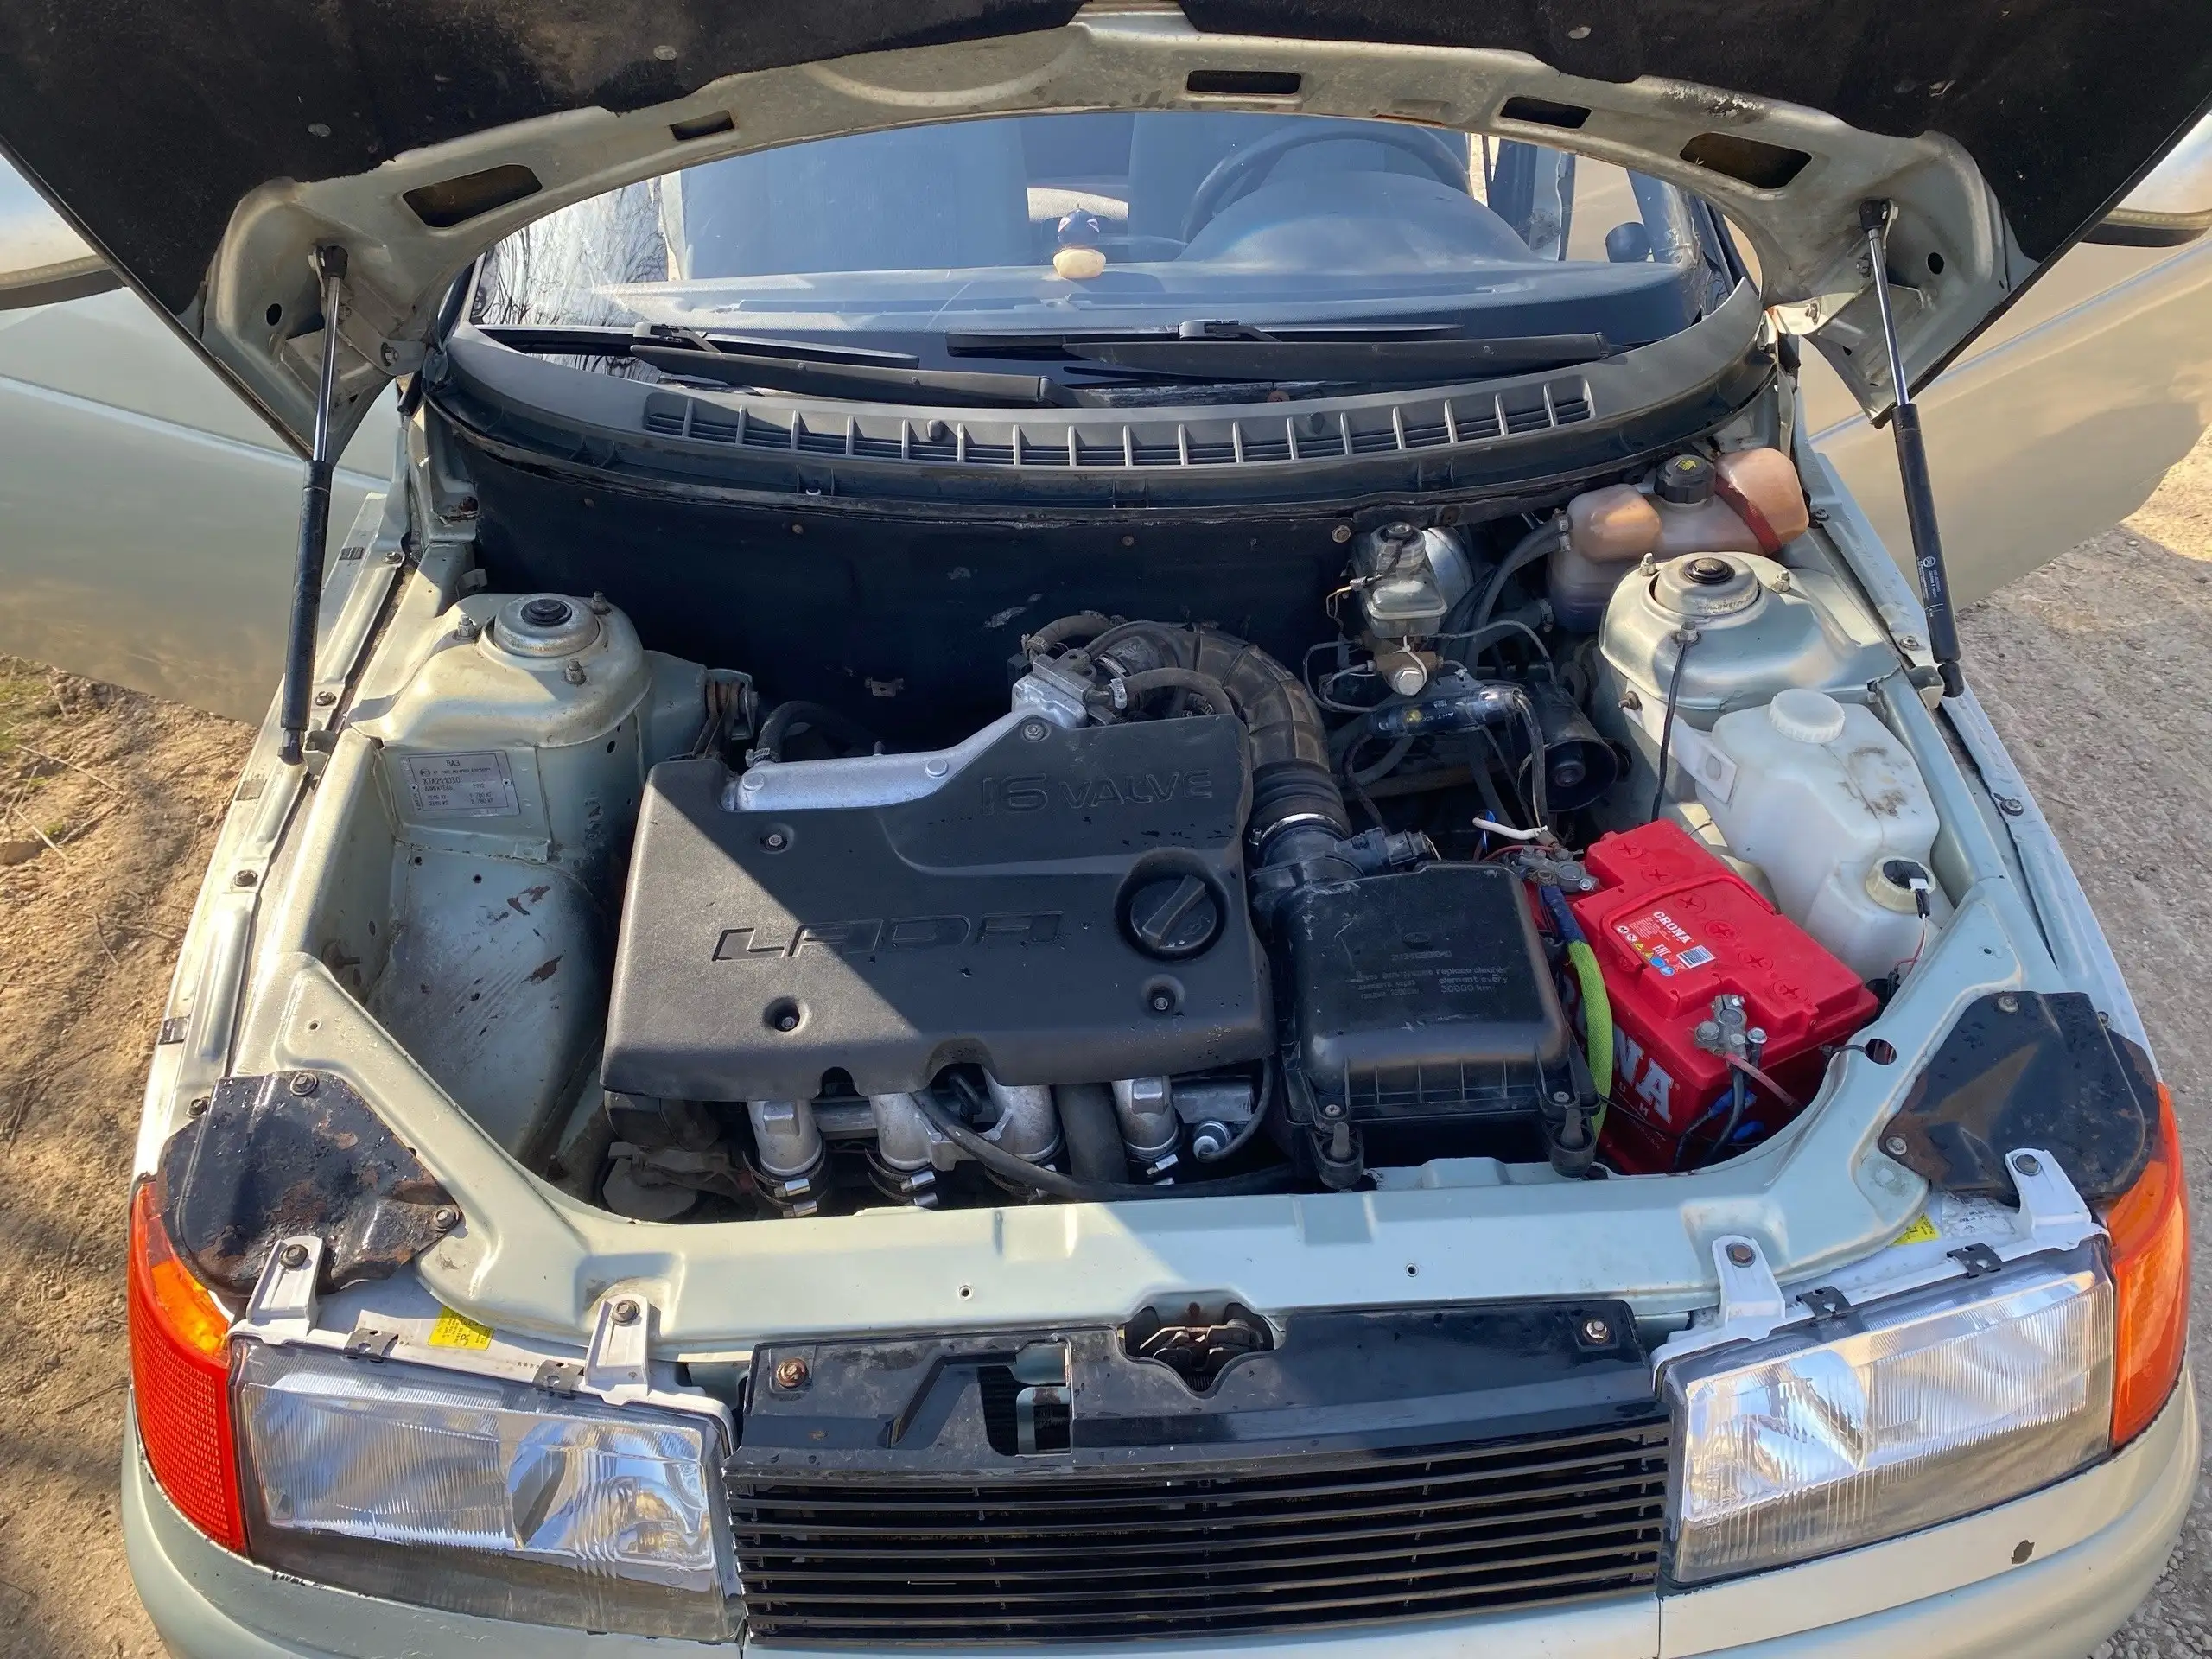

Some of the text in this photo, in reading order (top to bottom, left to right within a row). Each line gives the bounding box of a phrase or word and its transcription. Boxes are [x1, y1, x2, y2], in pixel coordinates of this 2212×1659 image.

[981, 768, 1213, 817] 16 VALVE
[712, 910, 1065, 962] LADA
[1653, 911, 1693, 944] CRONA
